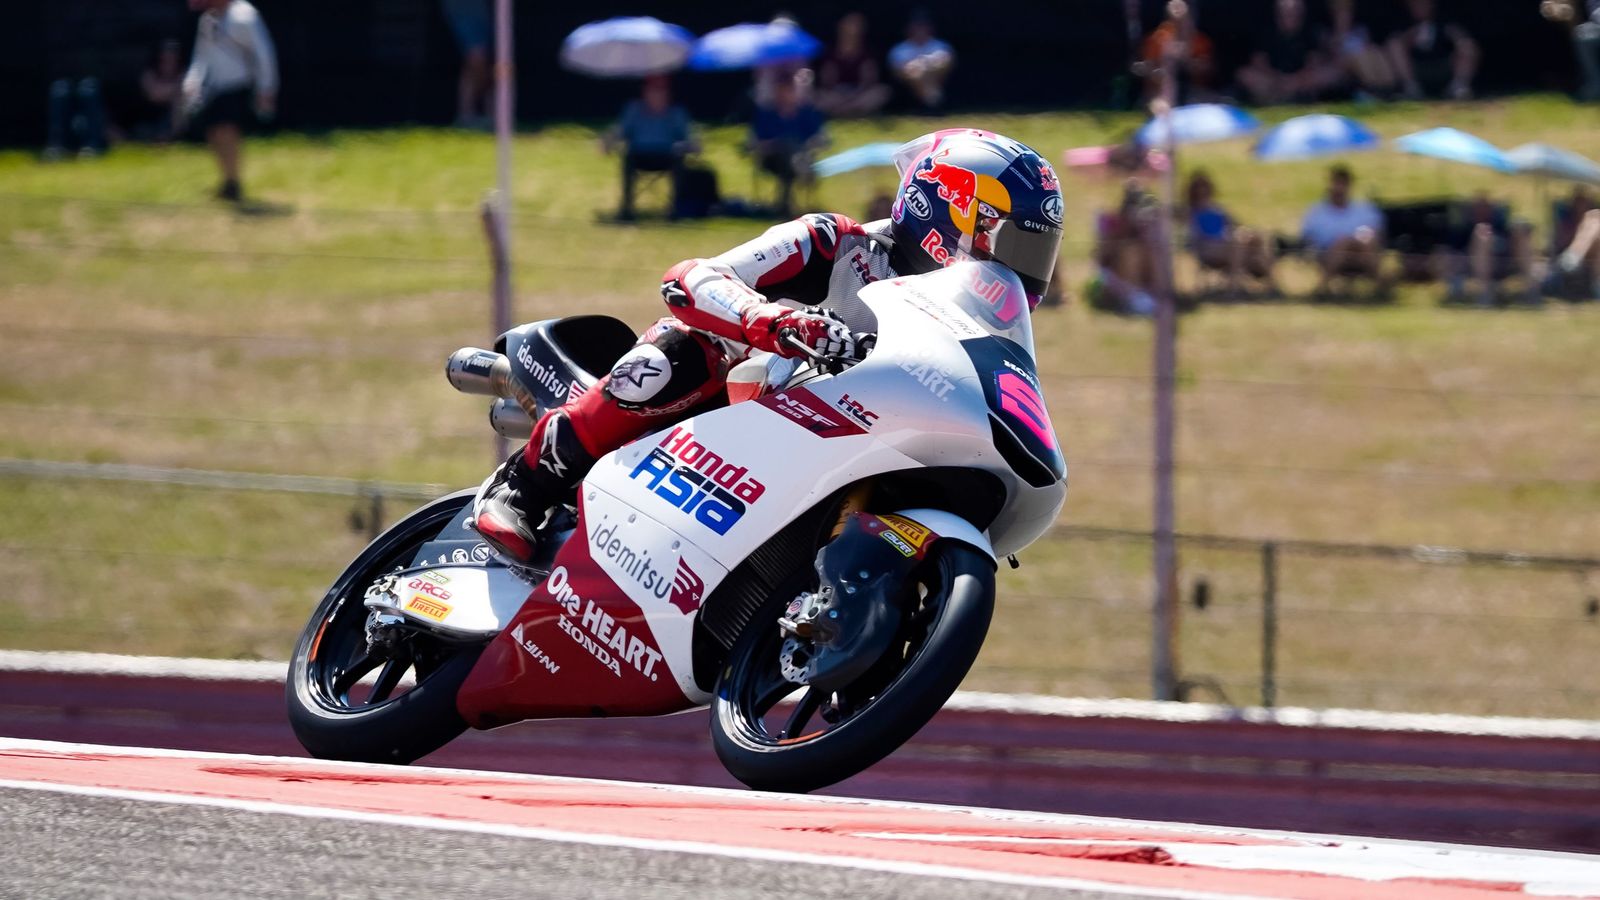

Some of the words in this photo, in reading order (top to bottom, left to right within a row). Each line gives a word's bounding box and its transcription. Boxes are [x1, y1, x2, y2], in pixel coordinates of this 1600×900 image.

[1024, 219, 1050, 233] GIVES
[516, 339, 567, 398] idemitsu
[775, 393, 840, 426] NSF
[837, 394, 880, 427] HRC
[658, 426, 766, 505] Honda
[590, 514, 672, 599] idemitsu
[409, 597, 448, 618] PIRELLI
[547, 566, 581, 617] One
[581, 599, 662, 682] HEART.
[557, 613, 621, 678] HONDA
